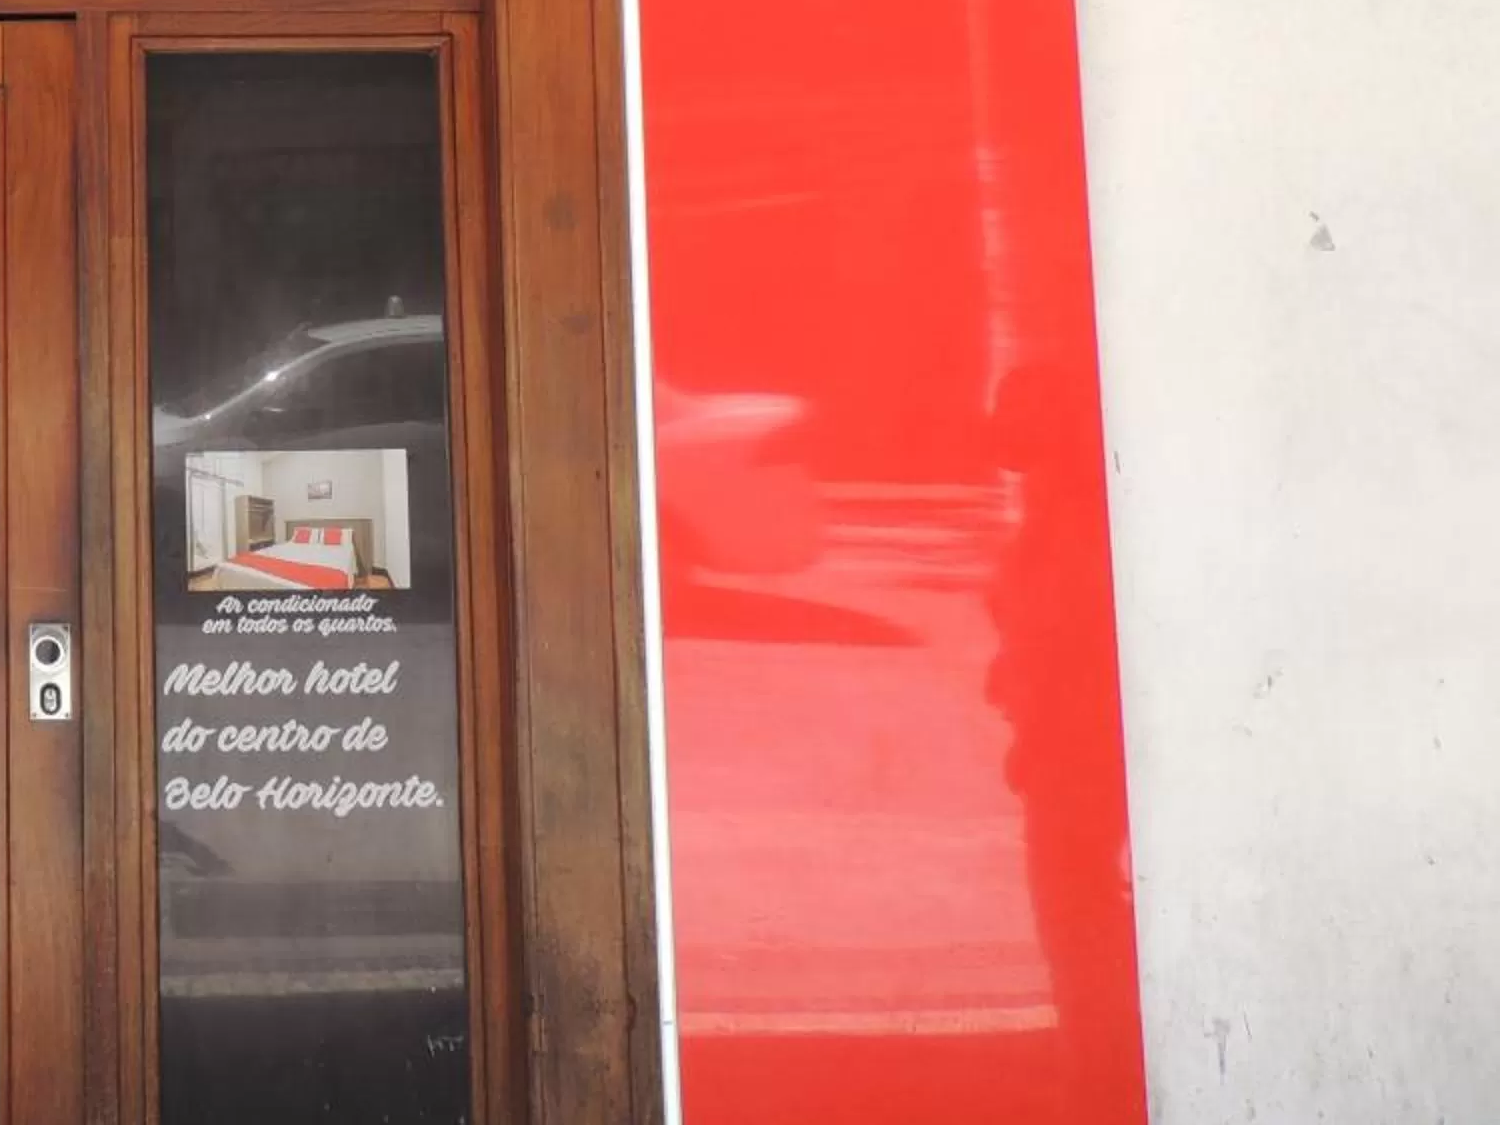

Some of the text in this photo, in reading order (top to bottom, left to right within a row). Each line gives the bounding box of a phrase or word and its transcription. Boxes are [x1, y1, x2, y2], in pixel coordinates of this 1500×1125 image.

[216, 593, 379, 614] Ar condicionado
[202, 614, 398, 637] em todos os quartos.
[164, 660, 401, 696] Melhor hotel
[162, 717, 389, 753] do centro de
[164, 776, 445, 818] Belo Horizonte.
